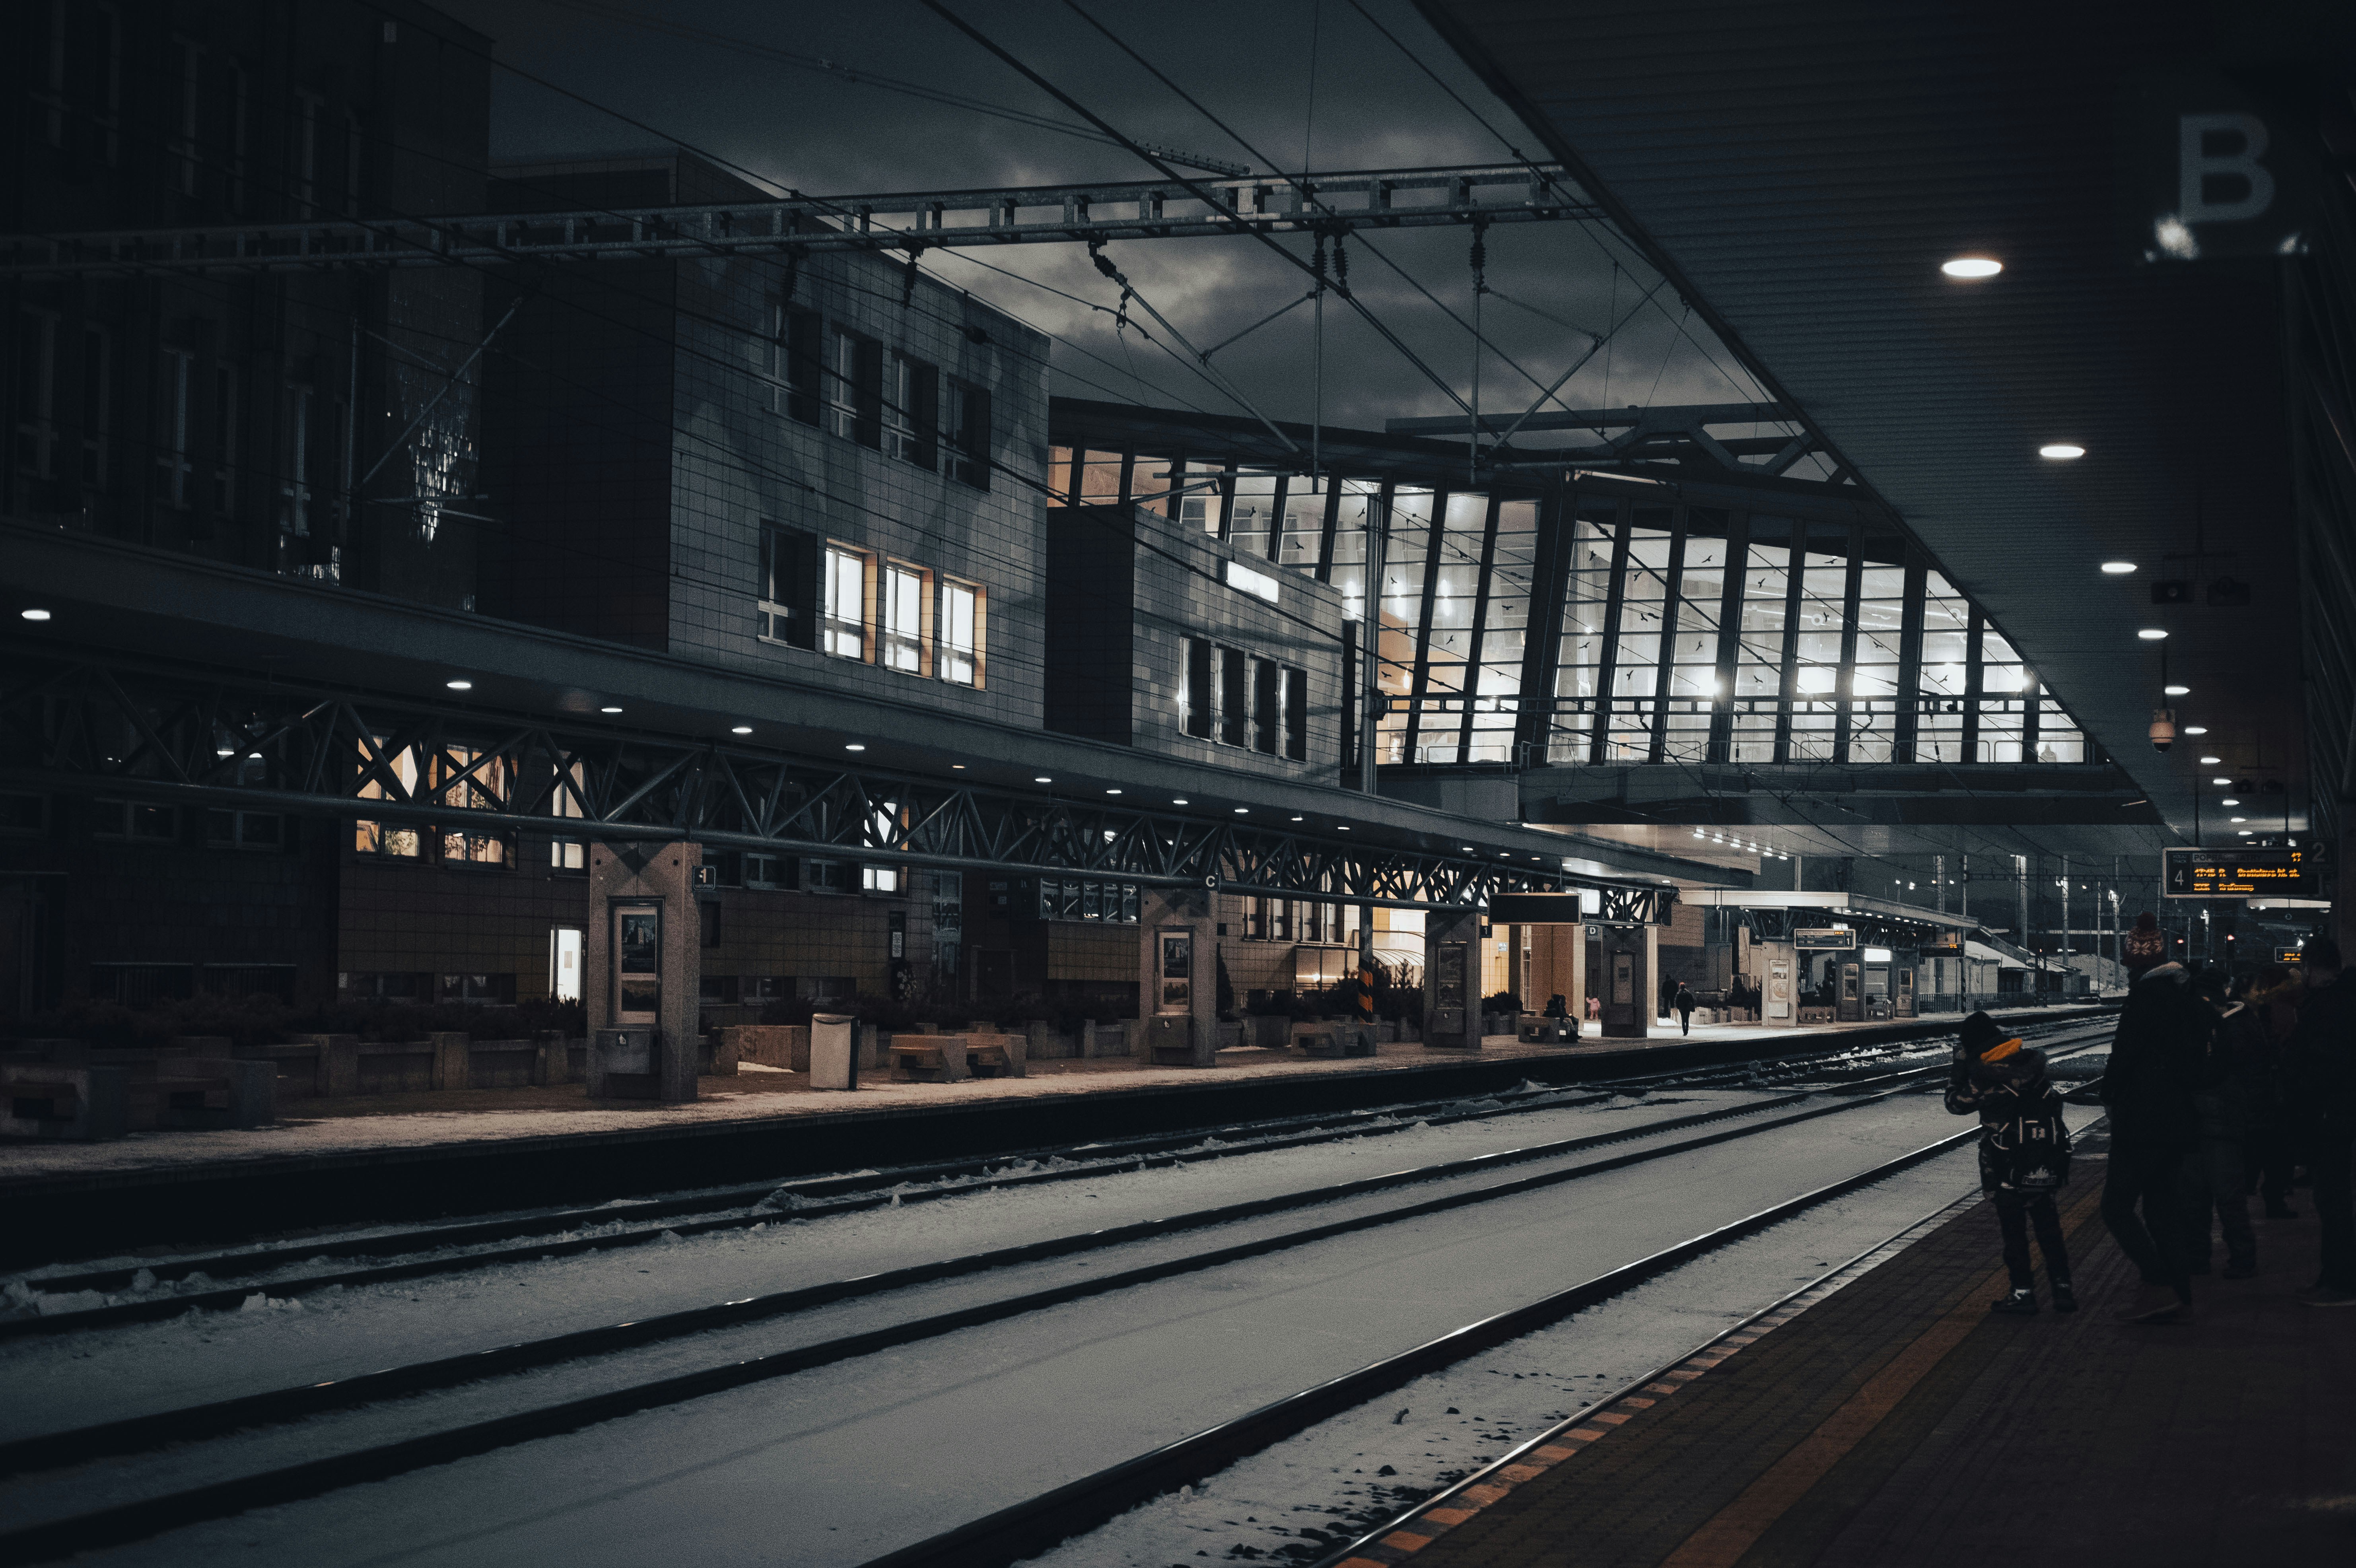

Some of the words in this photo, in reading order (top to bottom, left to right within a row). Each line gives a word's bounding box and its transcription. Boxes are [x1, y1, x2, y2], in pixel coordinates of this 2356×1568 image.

[2179, 113, 2276, 223] B
[2312, 842, 2325, 862] 2
[700, 868, 706, 883] 1
[1206, 875, 1215, 887] C
[2175, 870, 2184, 886] 4
[1484, 926, 1487, 935] 1
[2317, 925, 2323, 934] 2
